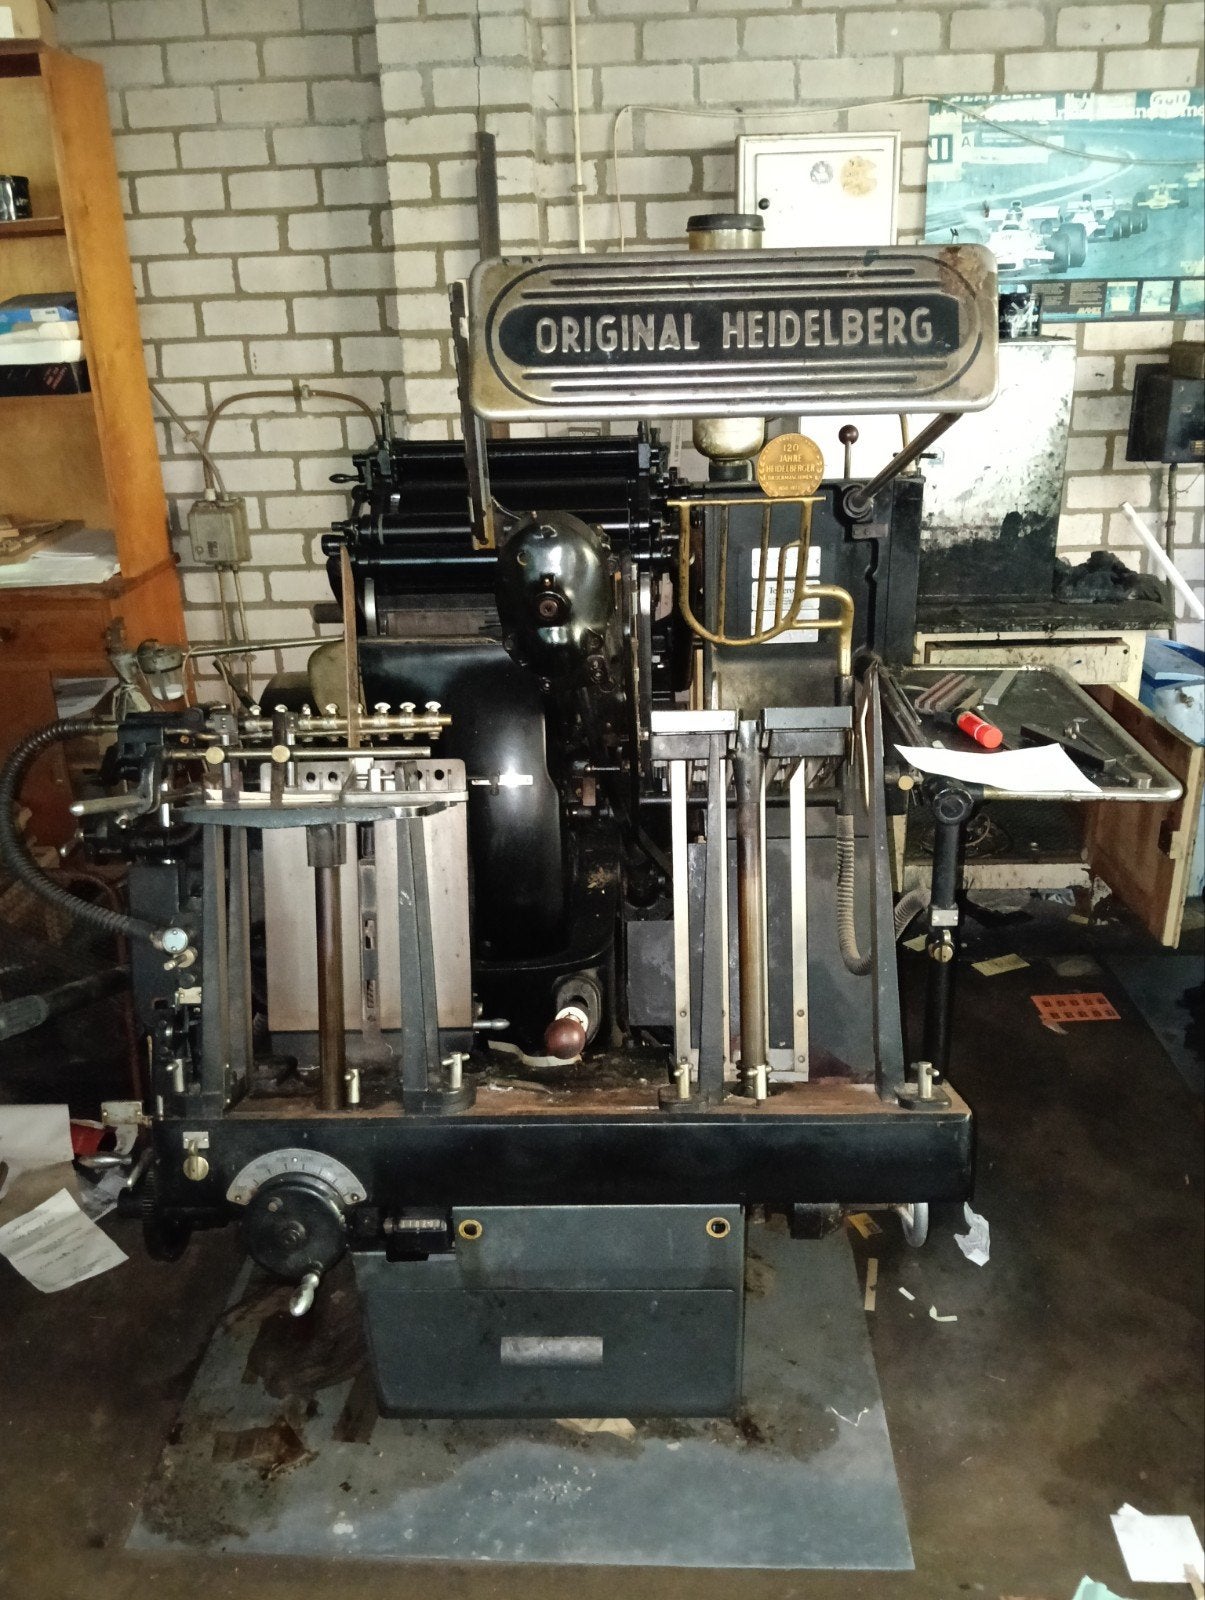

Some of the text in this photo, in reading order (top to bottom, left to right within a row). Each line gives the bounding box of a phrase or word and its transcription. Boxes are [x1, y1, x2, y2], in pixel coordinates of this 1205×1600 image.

[535, 306, 935, 354] ORIGINAL HEIDELBERG
[783, 443, 800, 453] 120
[779, 454, 803, 463] JAHRE
[766, 463, 816, 473] HEIDELBERGER
